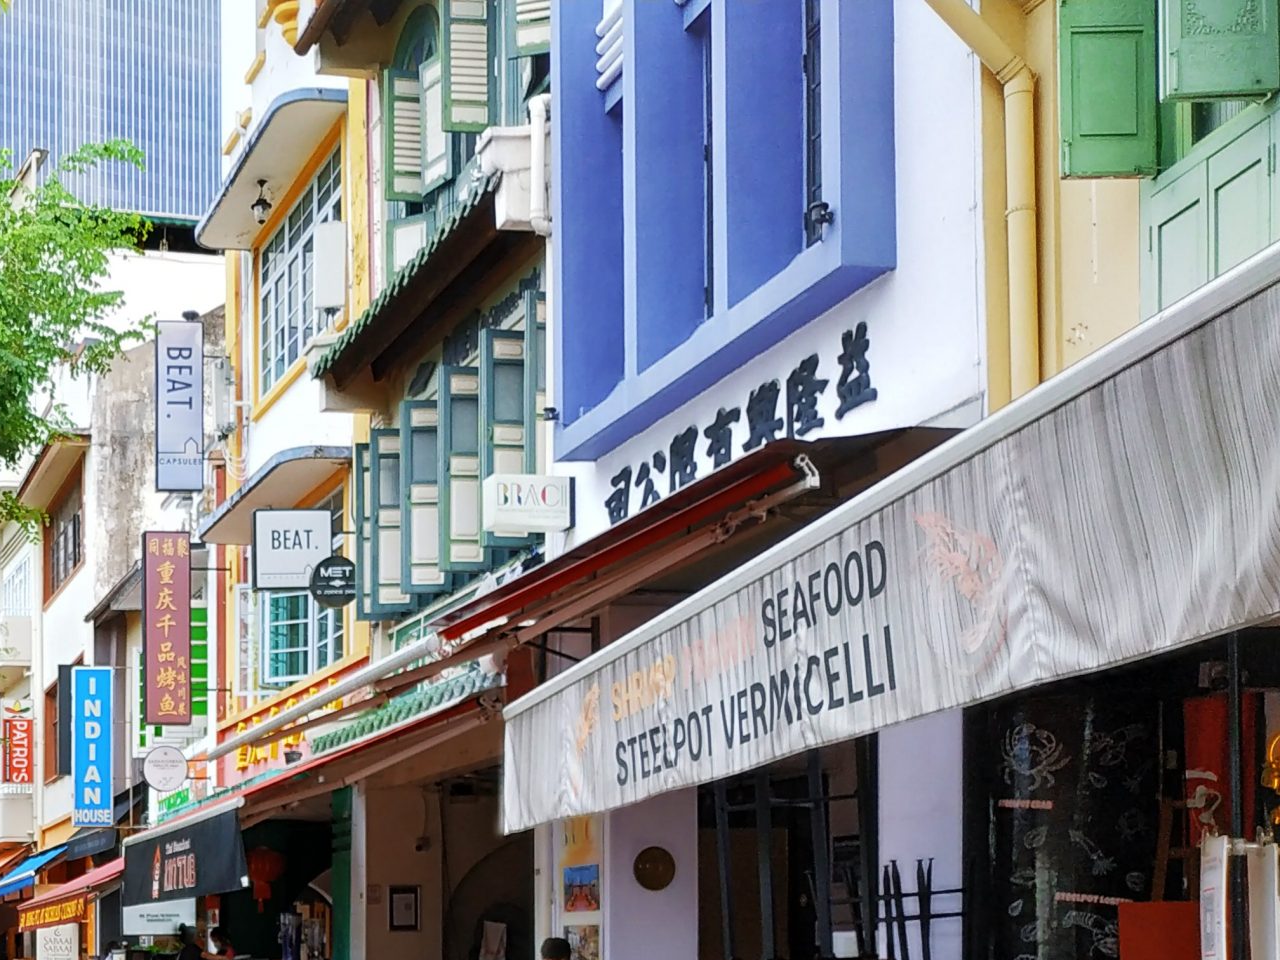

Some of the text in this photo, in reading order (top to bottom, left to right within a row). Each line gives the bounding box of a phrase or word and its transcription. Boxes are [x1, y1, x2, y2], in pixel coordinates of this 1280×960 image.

[159, 457, 203, 466] CAPSULES
[271, 529, 319, 550] BEAT.
[320, 566, 353, 578] MET
[761, 540, 887, 648] SEAFOOD
[155, 560, 178, 716] 重庆千品烤鱼
[720, 624, 897, 750] VERMICELLI
[12, 721, 29, 783] PATRO'S
[83, 676, 102, 805] INDIAN
[74, 808, 112, 823] HOUSE
